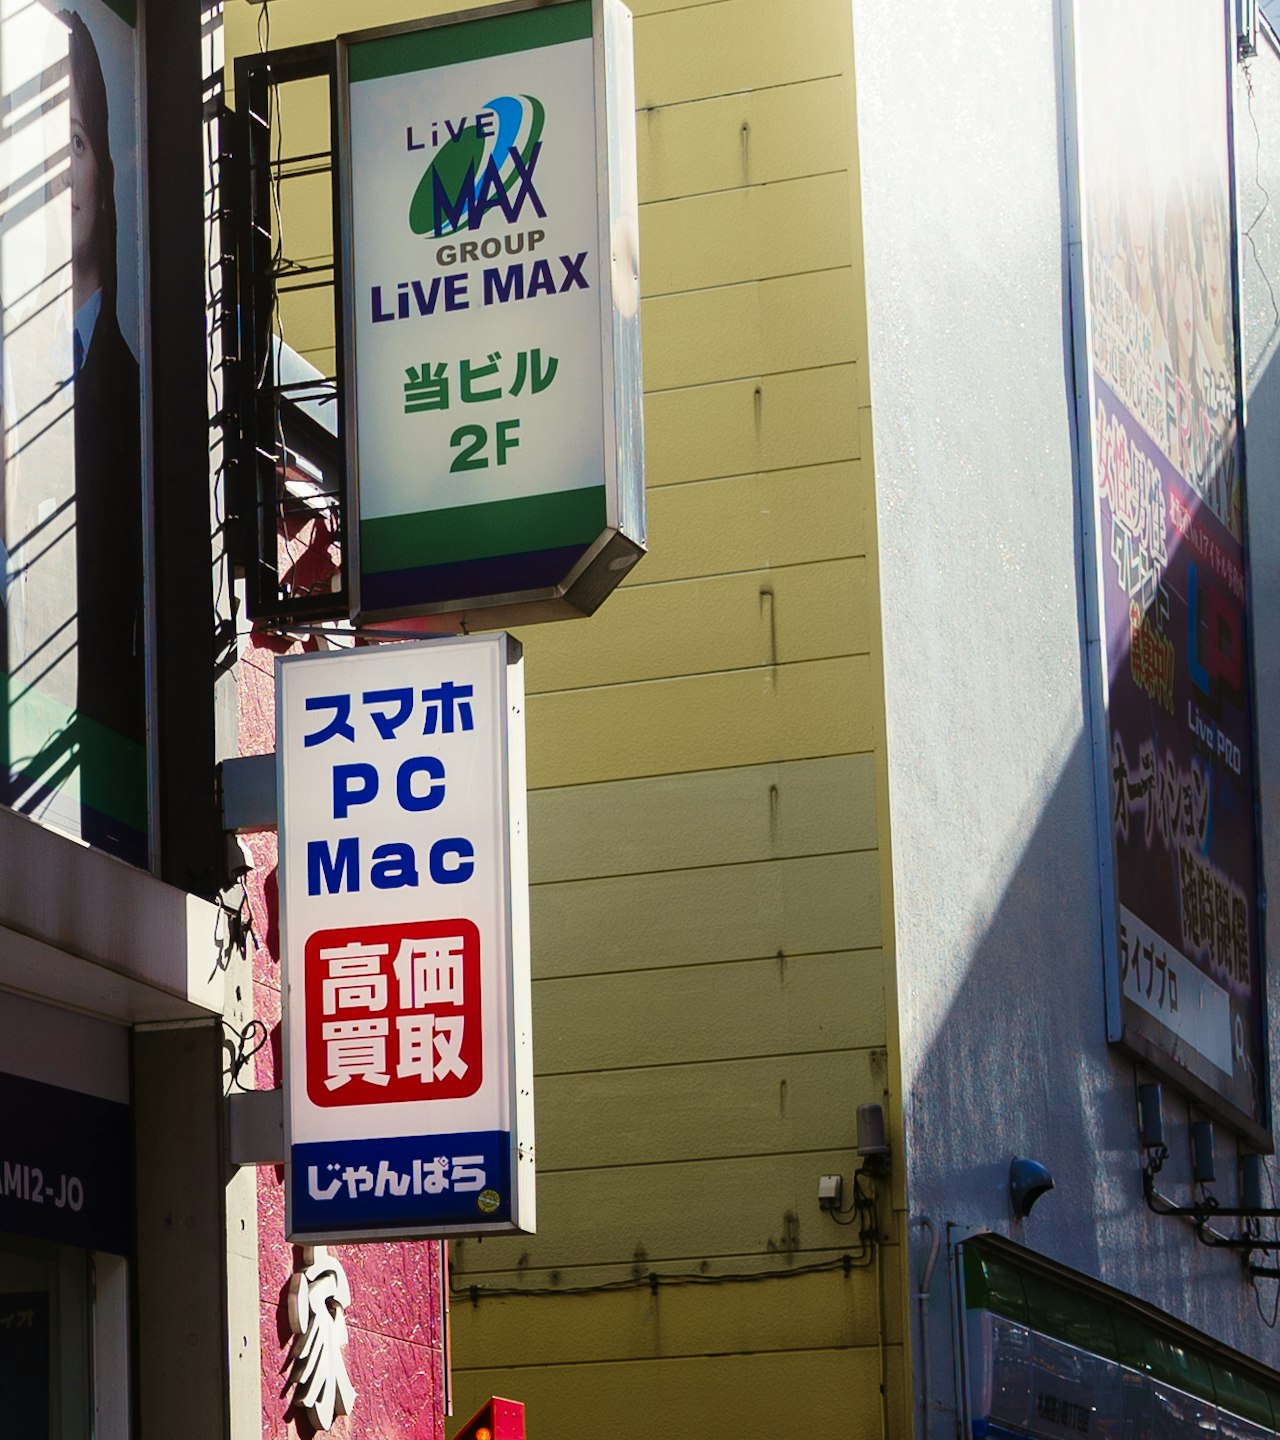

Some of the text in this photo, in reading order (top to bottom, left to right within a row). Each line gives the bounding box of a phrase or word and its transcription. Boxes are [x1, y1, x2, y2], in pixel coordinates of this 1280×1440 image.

[405, 110, 495, 152] LiVE
[431, 140, 547, 238] MAX
[435, 229, 546, 267] GROUP
[371, 251, 590, 325] LiVE MAX
[403, 347, 560, 416] 当ビル
[448, 418, 521, 474] 2F
[303, 681, 474, 748] スマホ
[1187, 699, 1215, 750] Live
[332, 755, 447, 819] PC
[306, 837, 475, 897] Mac
[318, 936, 466, 1016] 高価
[322, 1013, 469, 1091] 買取
[307, 1155, 486, 1201] じゃんぱら
